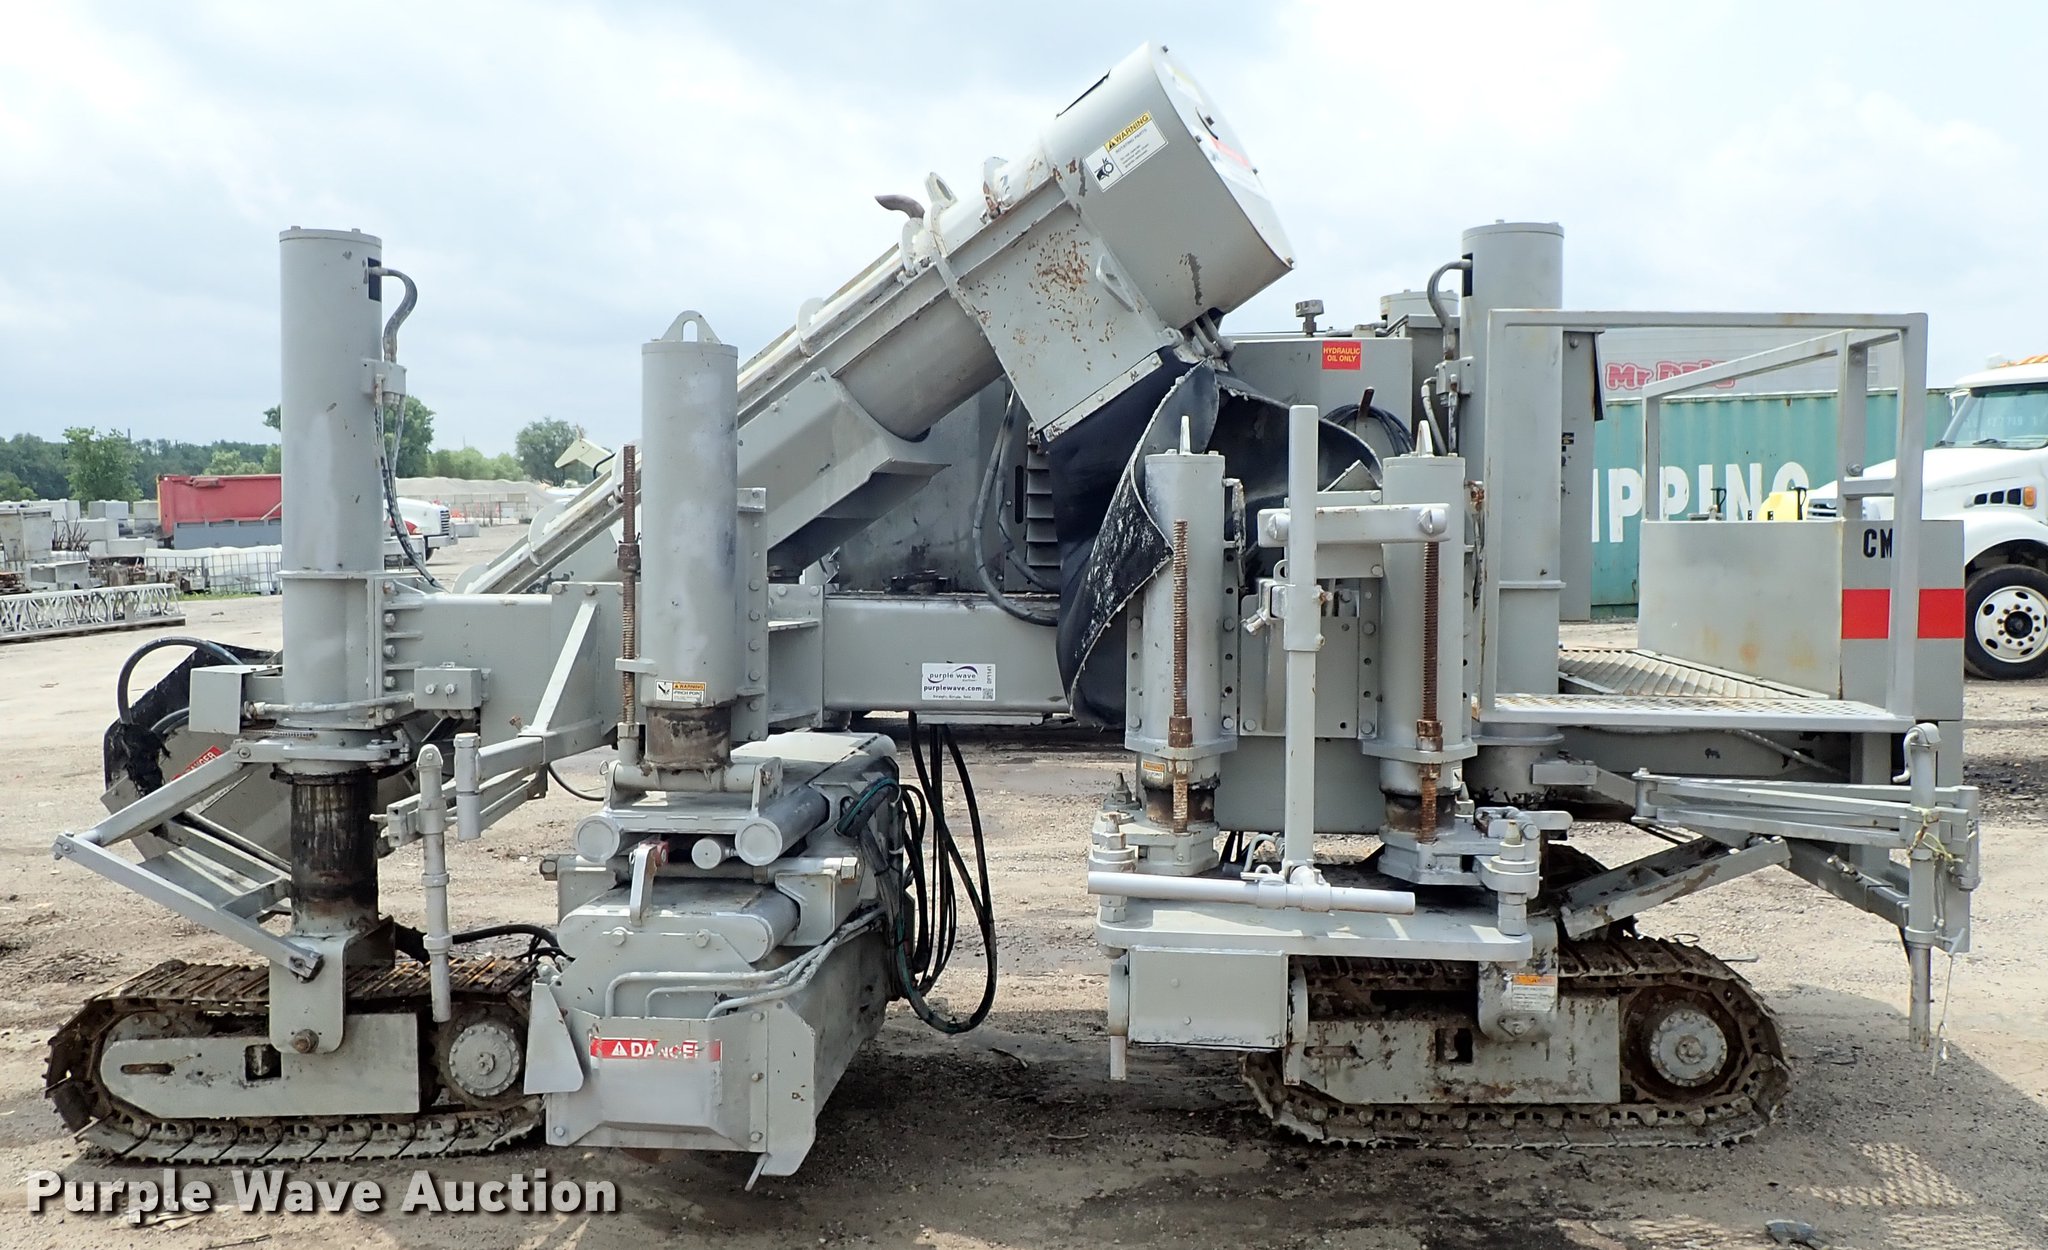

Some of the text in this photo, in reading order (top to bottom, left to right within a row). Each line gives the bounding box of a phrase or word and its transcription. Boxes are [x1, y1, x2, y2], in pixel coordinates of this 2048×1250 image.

[1114, 115, 1149, 142] WARNING
[1323, 347, 1361, 355] HYDRAULIC
[1606, 363, 1654, 390] Mr
[929, 672, 954, 681] purple
[923, 684, 982, 692] purplewave.com
